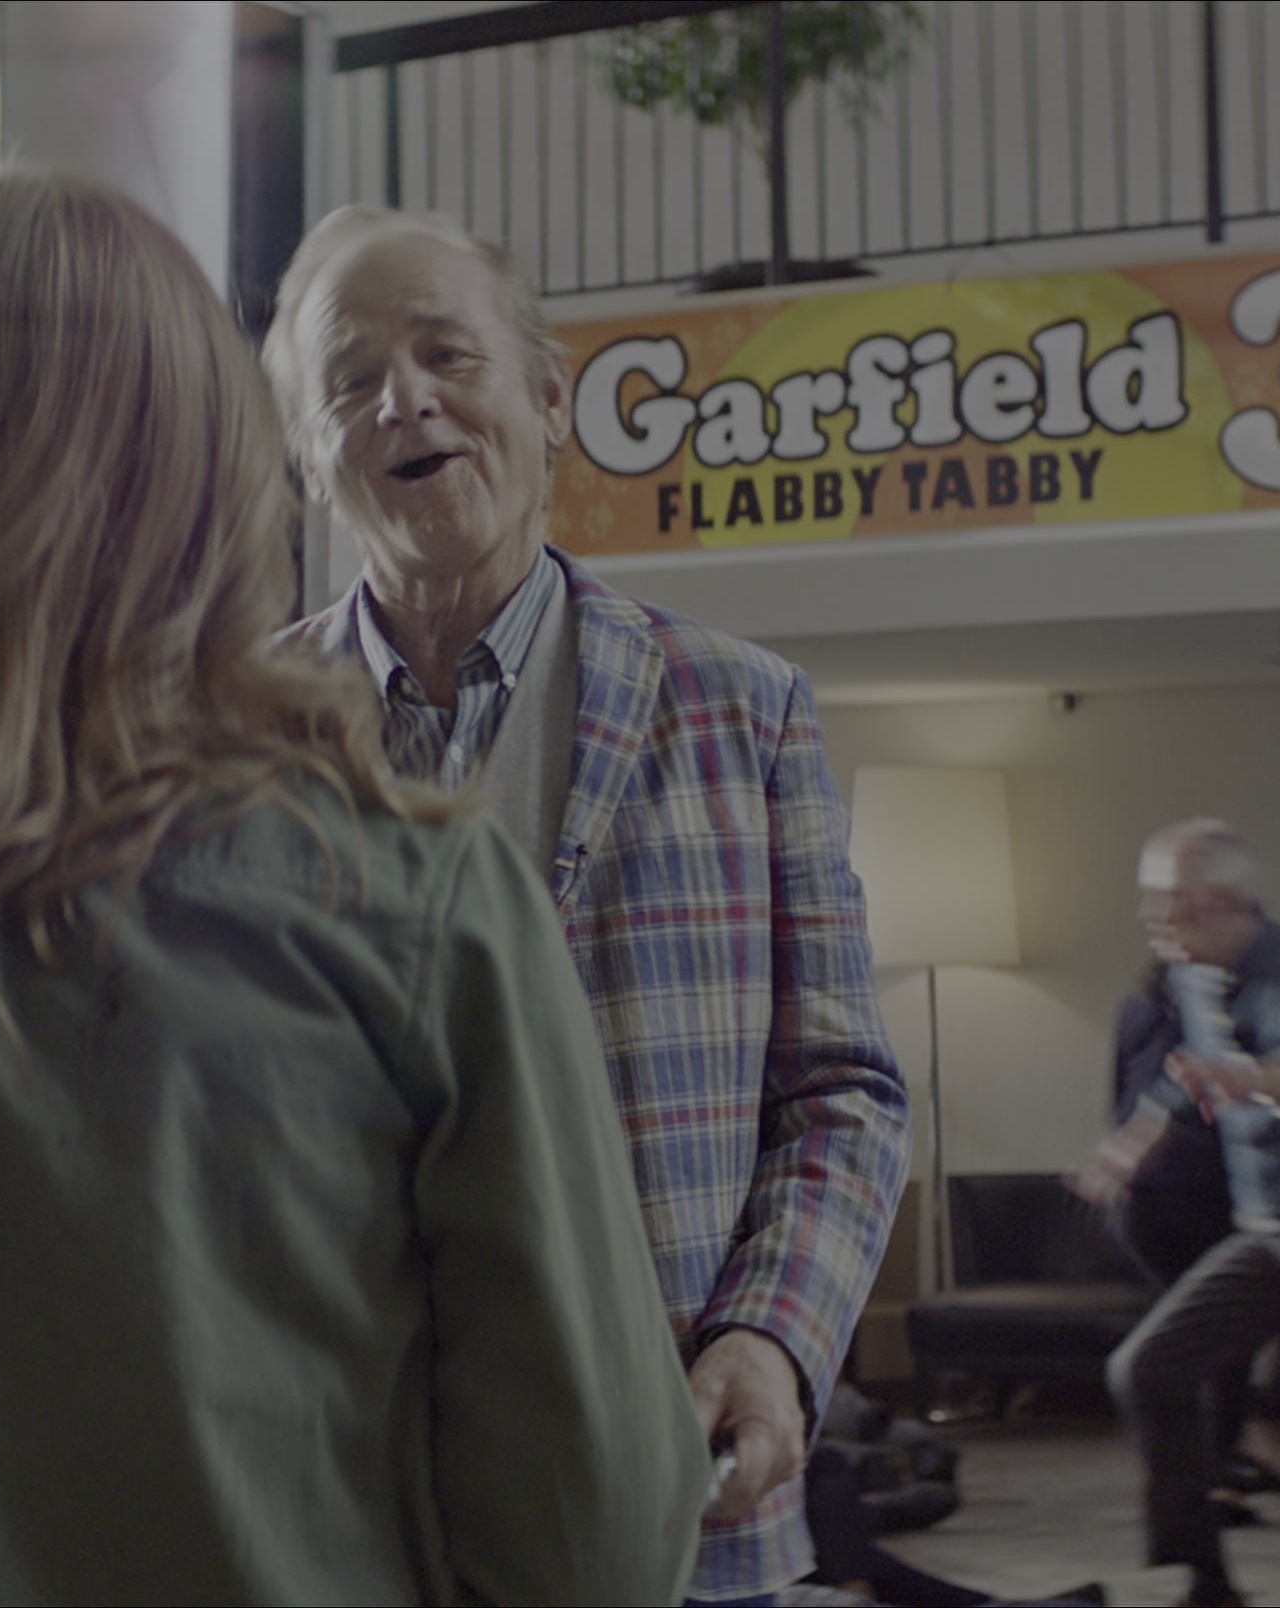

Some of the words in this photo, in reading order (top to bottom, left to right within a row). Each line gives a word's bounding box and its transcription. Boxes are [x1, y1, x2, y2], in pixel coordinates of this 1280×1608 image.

[573, 312, 1188, 475] Garfield
[657, 464, 884, 533] FLABBY
[902, 448, 1104, 513] TABBY
